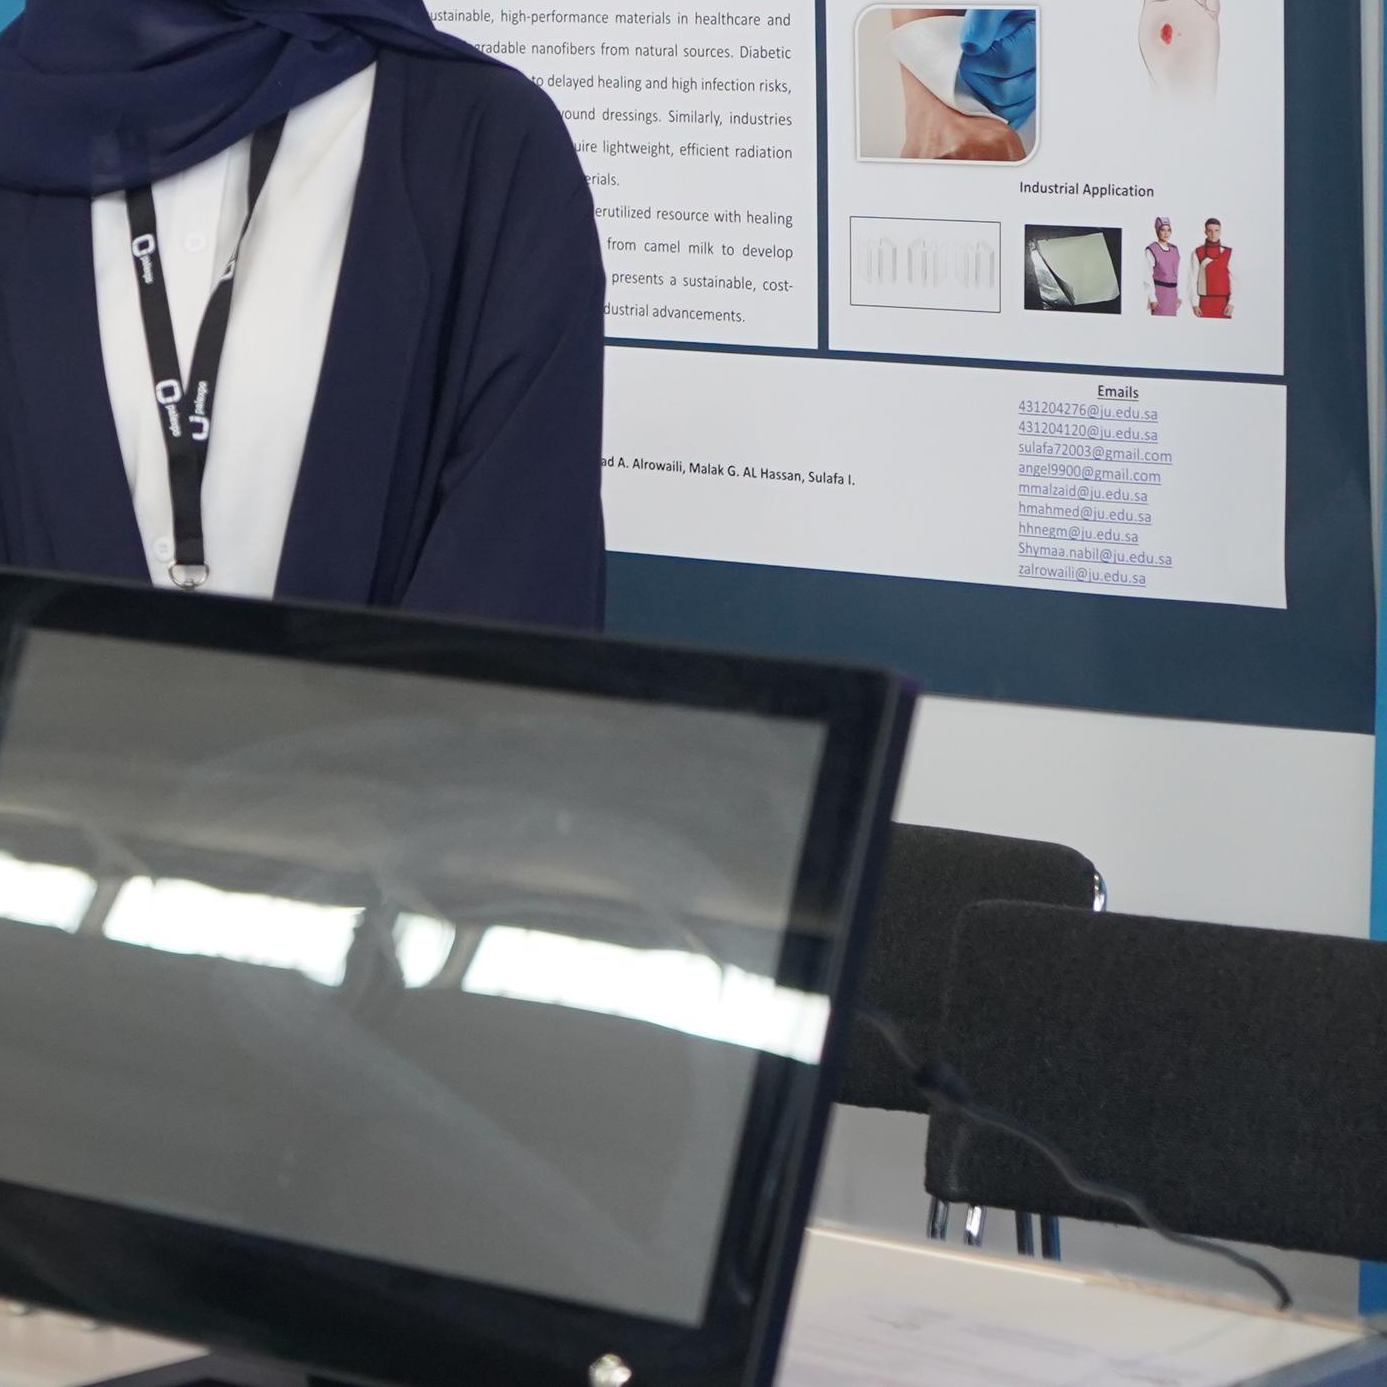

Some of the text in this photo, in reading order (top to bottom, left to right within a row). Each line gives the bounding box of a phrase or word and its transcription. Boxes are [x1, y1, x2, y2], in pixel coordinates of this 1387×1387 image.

[1019, 181, 1155, 199] Industrial Application
[1097, 385, 1139, 401] Emails
